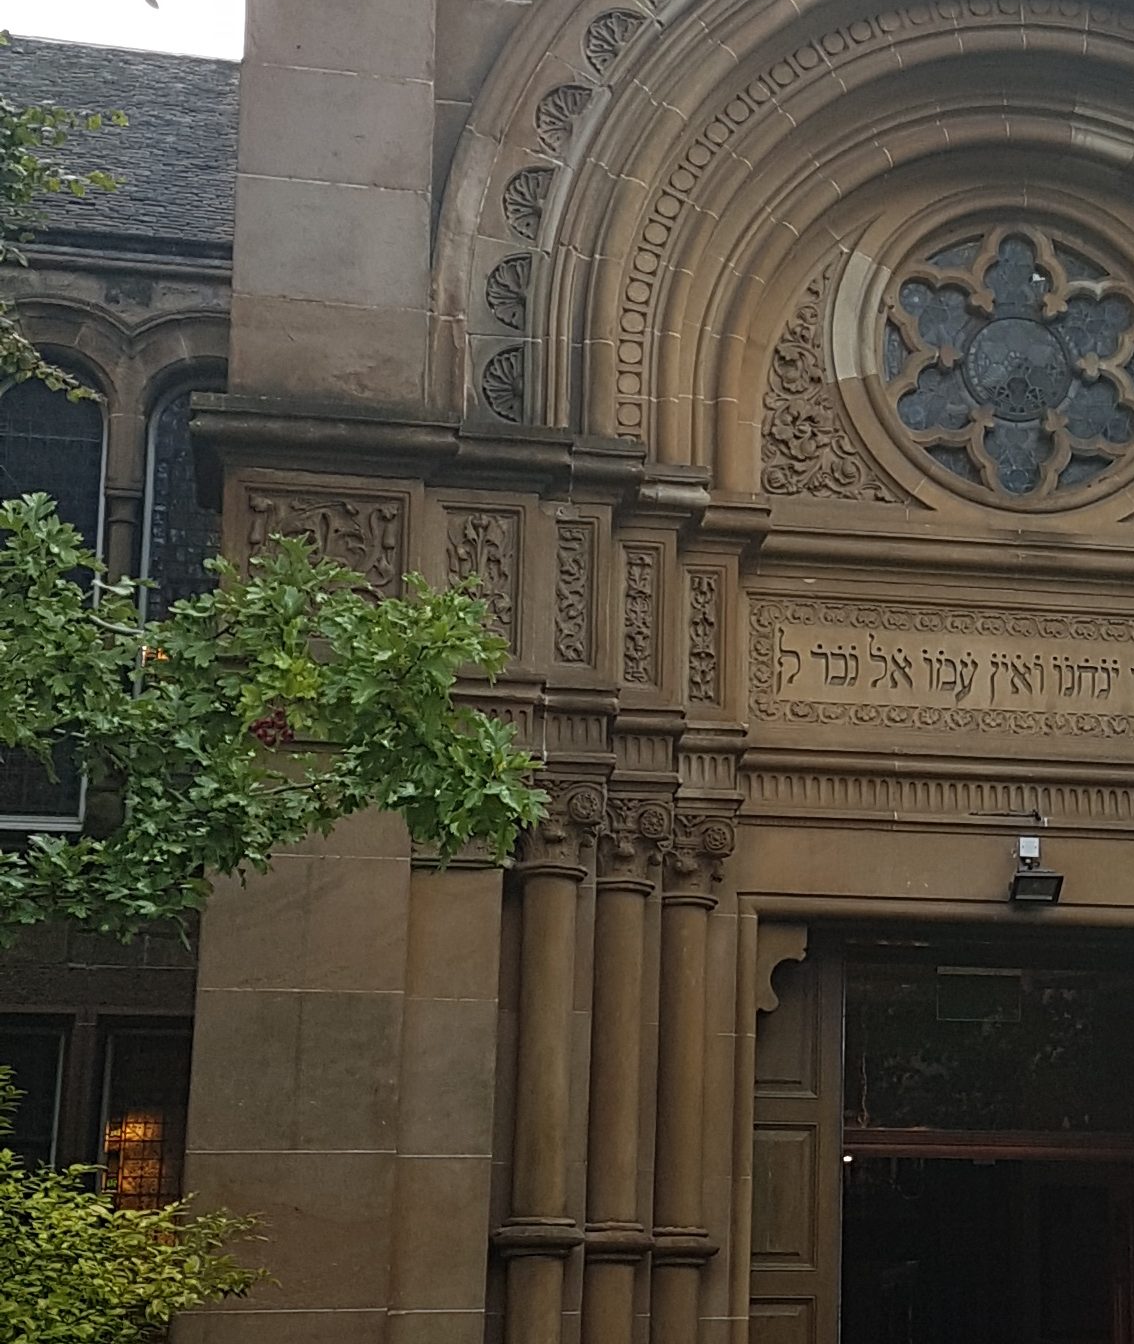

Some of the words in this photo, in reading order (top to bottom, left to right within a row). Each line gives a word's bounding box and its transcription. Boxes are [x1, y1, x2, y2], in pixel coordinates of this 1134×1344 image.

[810, 643, 859, 688] נכר
[868, 633, 914, 689] אל
[922, 649, 979, 705] עמו
[990, 653, 1045, 706] ואין
[1052, 656, 1121, 700] ינחנו
